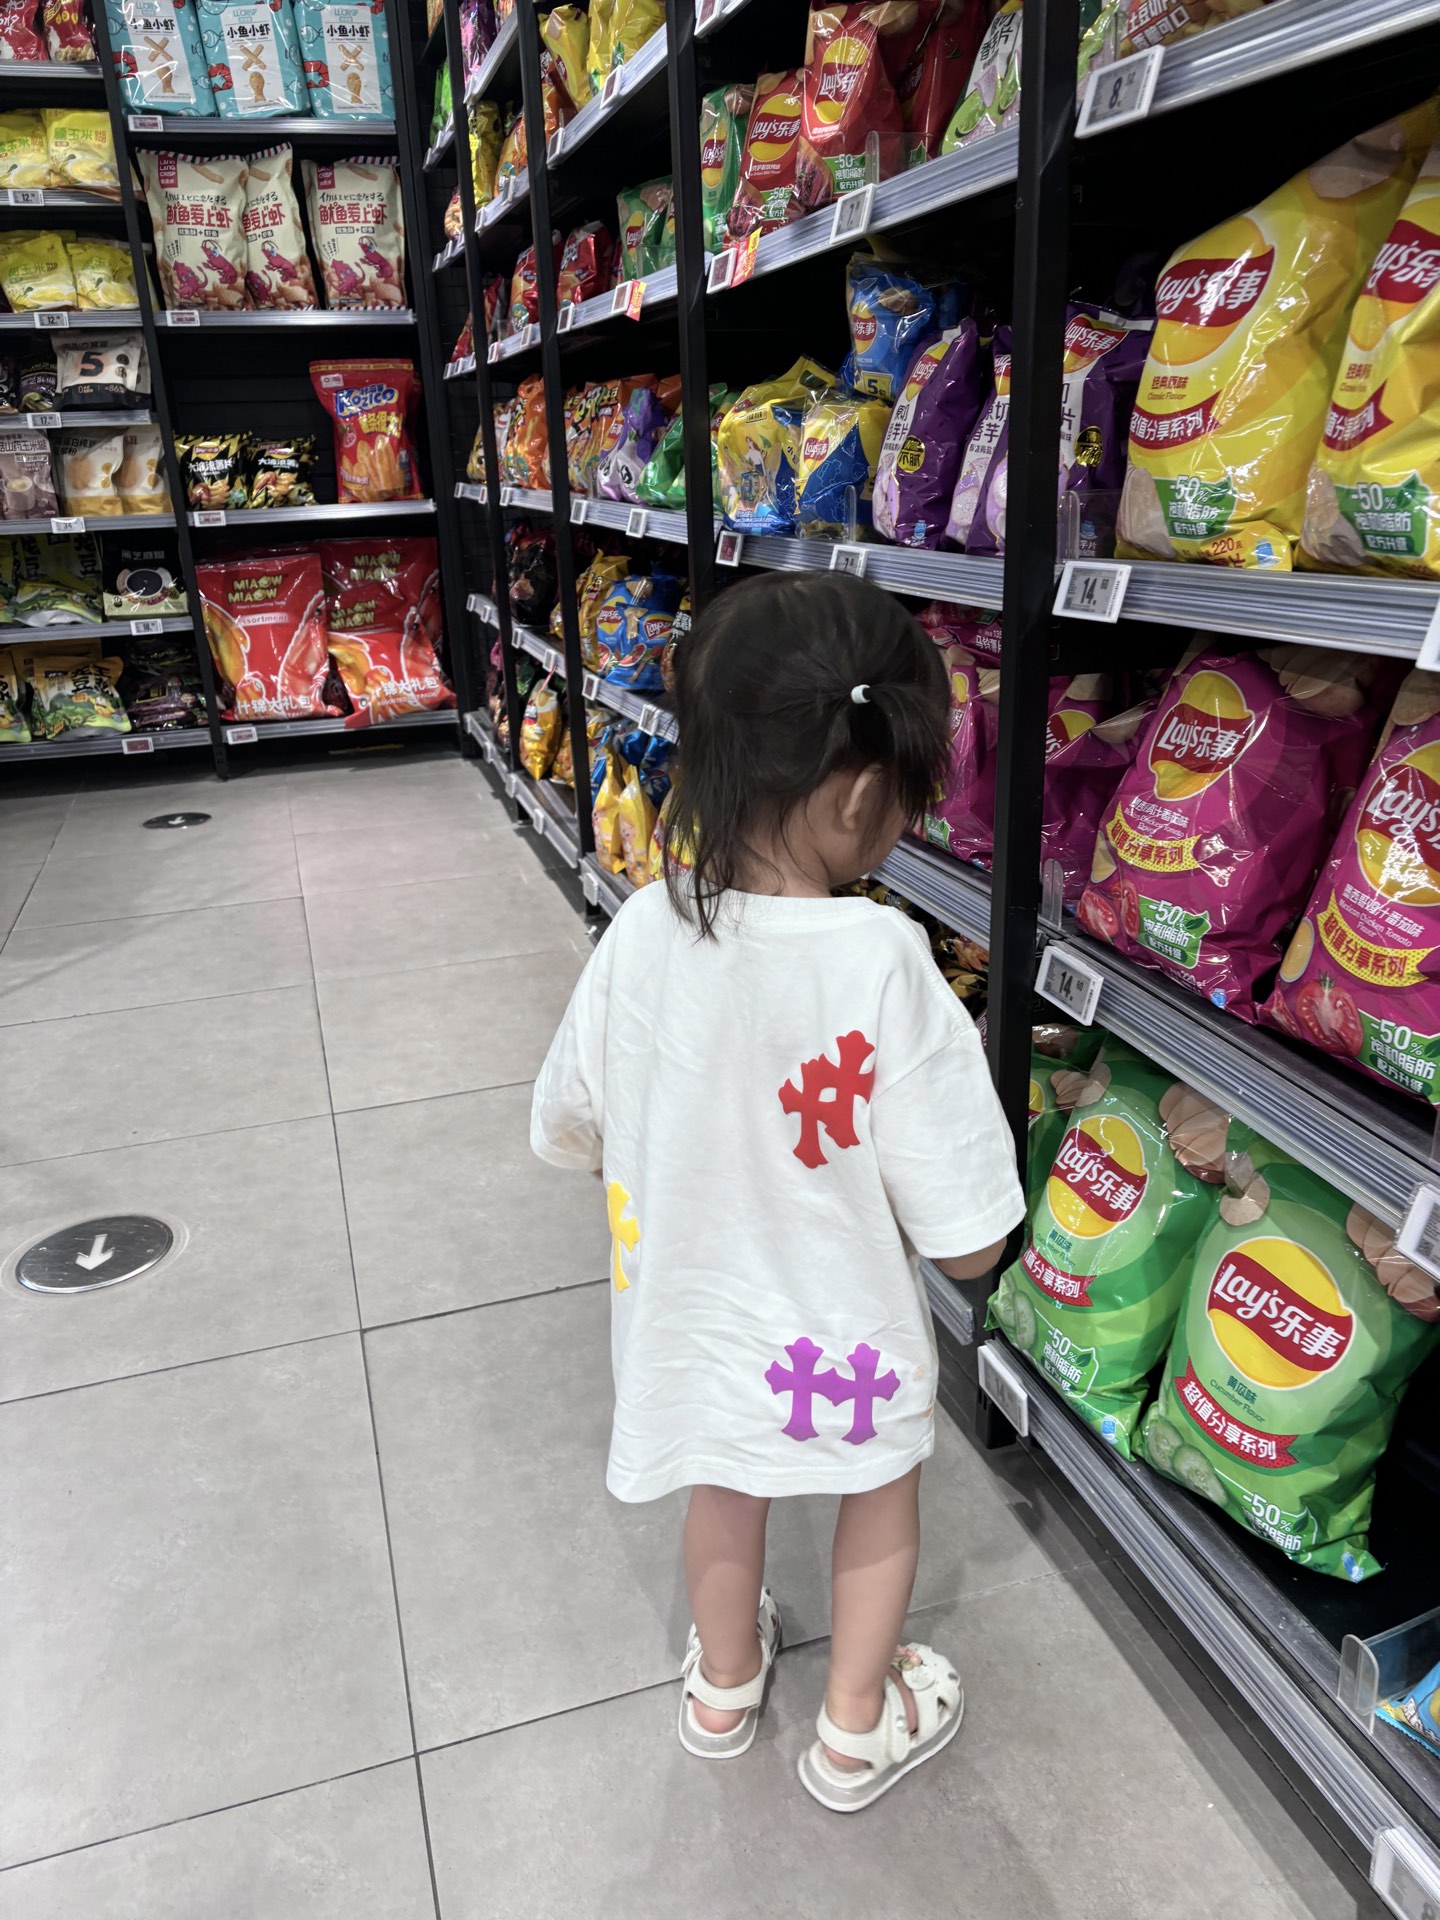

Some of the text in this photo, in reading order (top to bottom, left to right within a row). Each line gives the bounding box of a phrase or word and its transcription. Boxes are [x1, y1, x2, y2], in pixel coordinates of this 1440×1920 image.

[226, 24, 271, 39] 小鱼小虾
[326, 24, 371, 38] 小鱼小虾
[166, 201, 233, 229] 鱿鱼爱上虾
[319, 202, 388, 226] 鱿鱼爱上虾
[79, 352, 104, 377] 5
[1170, 475, 1208, 503] -50%
[1351, 483, 1397, 511] -50%
[1355, 512, 1412, 532] 饱和脂肪
[228, 588, 277, 604] MIAOW
[233, 575, 283, 590] MIAOW
[331, 612, 374, 630] MIAOW
[236, 697, 312, 712] 什锦大礼包
[1158, 717, 1247, 761] Lay's乐事
[1366, 778, 1440, 848] Lay's
[1143, 916, 1189, 948] 饱和脂肪
[1323, 912, 1408, 978] 超值分享系列
[1360, 913, 1385, 932] Chicken
[1385, 927, 1412, 947] Tomato
[1370, 1018, 1423, 1056] -50%
[1370, 1036, 1437, 1080] 饱和脂肪
[1377, 1057, 1423, 1092] 配方升级
[1054, 1138, 1141, 1213] Lay's乐事
[1215, 1262, 1347, 1361] Lay's乐事
[1048, 1328, 1077, 1363] -50%
[1043, 1341, 1083, 1384] 饱和脂肪
[1210, 1379, 1265, 1422] Cucumber Flavor
[1226, 1375, 1257, 1406] 黄瓜味
[1183, 1381, 1277, 1460] 超值分享系列
[1243, 1493, 1291, 1532] -50%
